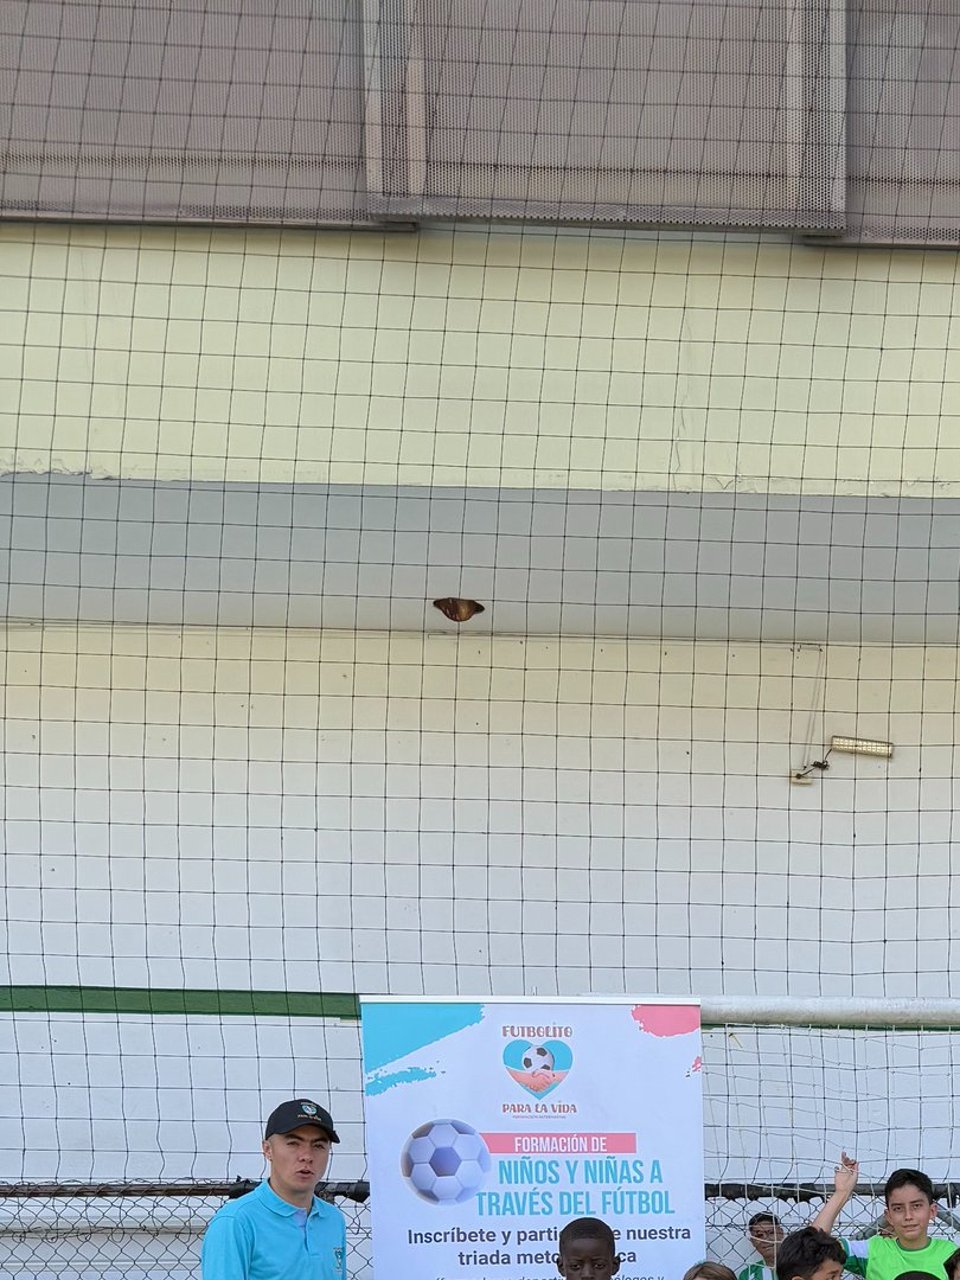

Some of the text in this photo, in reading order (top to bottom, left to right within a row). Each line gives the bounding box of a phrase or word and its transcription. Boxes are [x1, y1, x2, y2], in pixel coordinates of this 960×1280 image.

[502, 1104, 531, 1113] PARA
[535, 1103, 548, 1113] LA
[514, 1134, 607, 1152] FORMACIÓN DE
[499, 1156, 664, 1184] NIÑOS Y NIÑAS A
[475, 1187, 676, 1216] TRAVÉS DEL FÚTBOL
[408, 1227, 497, 1244] Inscríbete
[501, 1230, 512, 1246] y
[626, 1226, 691, 1240] nuestra
[458, 1249, 511, 1265] triada
